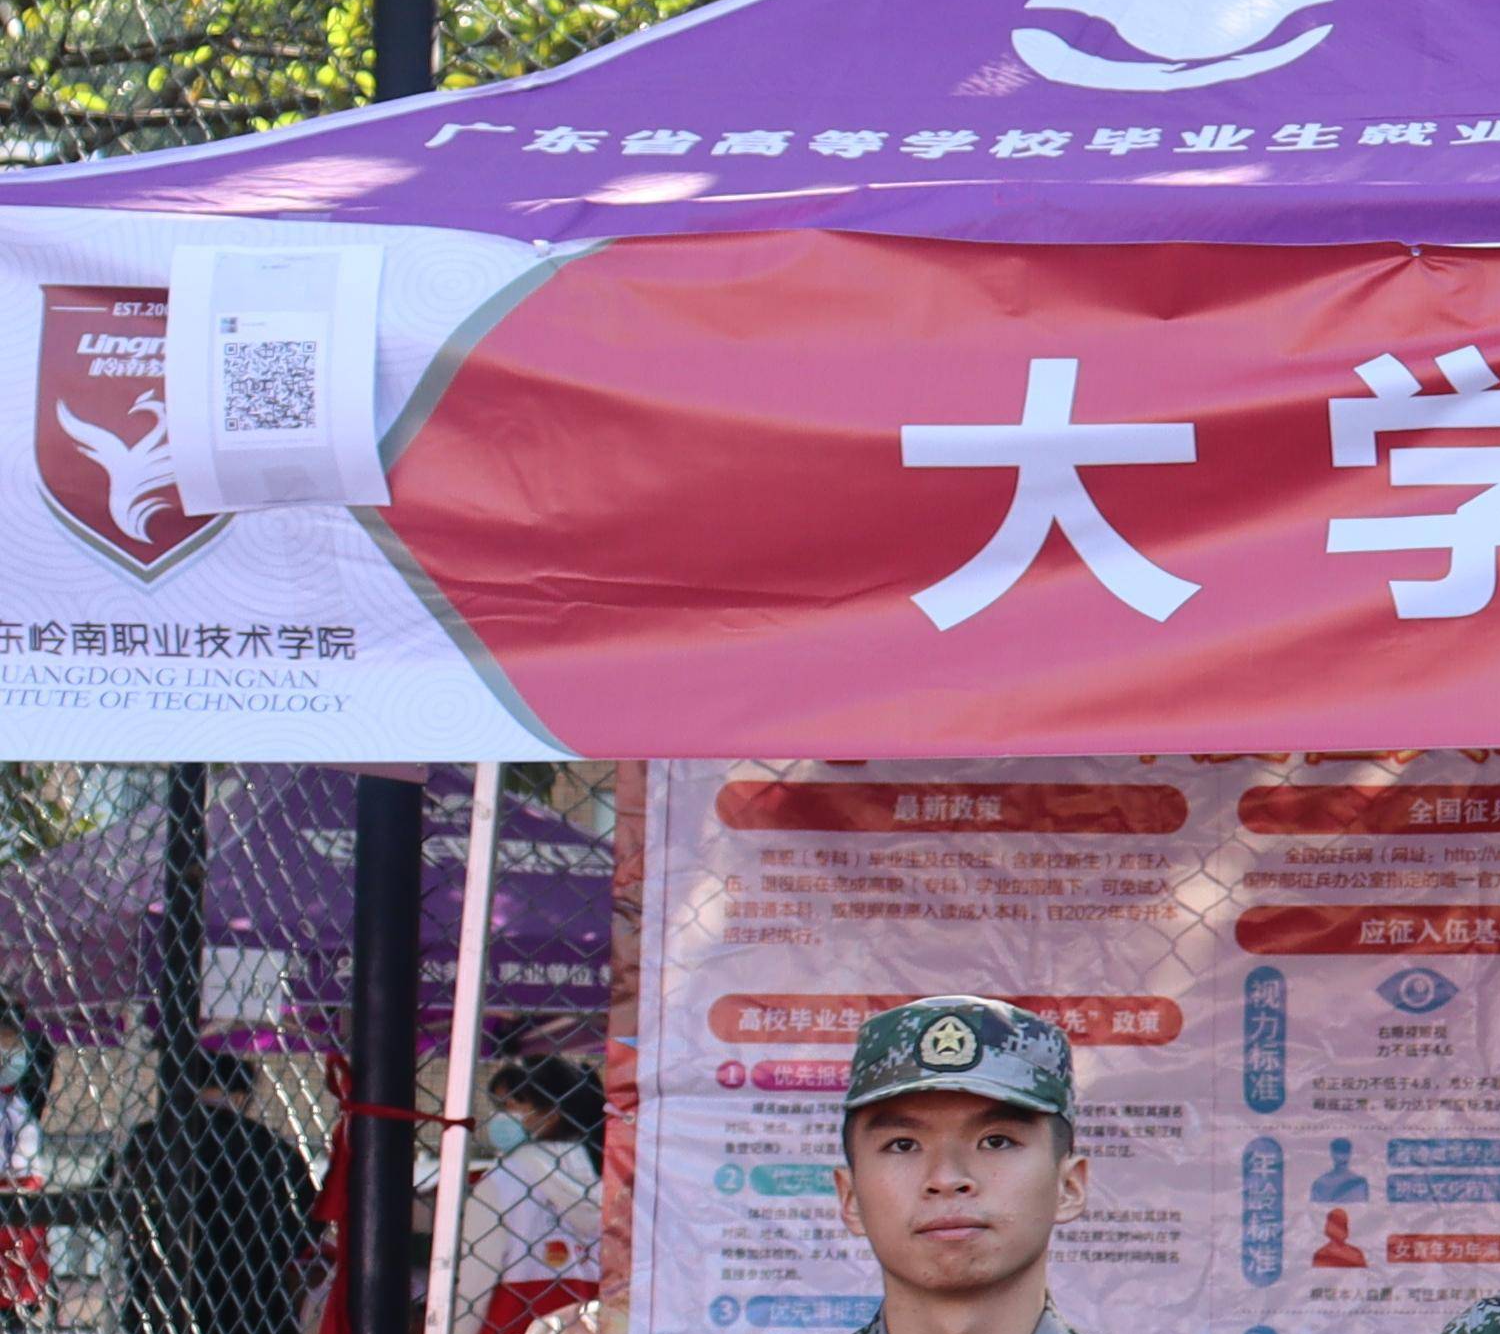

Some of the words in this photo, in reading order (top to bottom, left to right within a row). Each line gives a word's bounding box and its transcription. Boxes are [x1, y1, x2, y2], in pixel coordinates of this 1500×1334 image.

[185, 668, 322, 689] LINGNAN
[99, 689, 139, 710] OF
[150, 690, 351, 714] TECHNOLOGY
[892, 794, 1002, 822] 最新政策
[738, 1006, 868, 1033] 高校毕业生
[1248, 979, 1281, 1103] 视力标准
